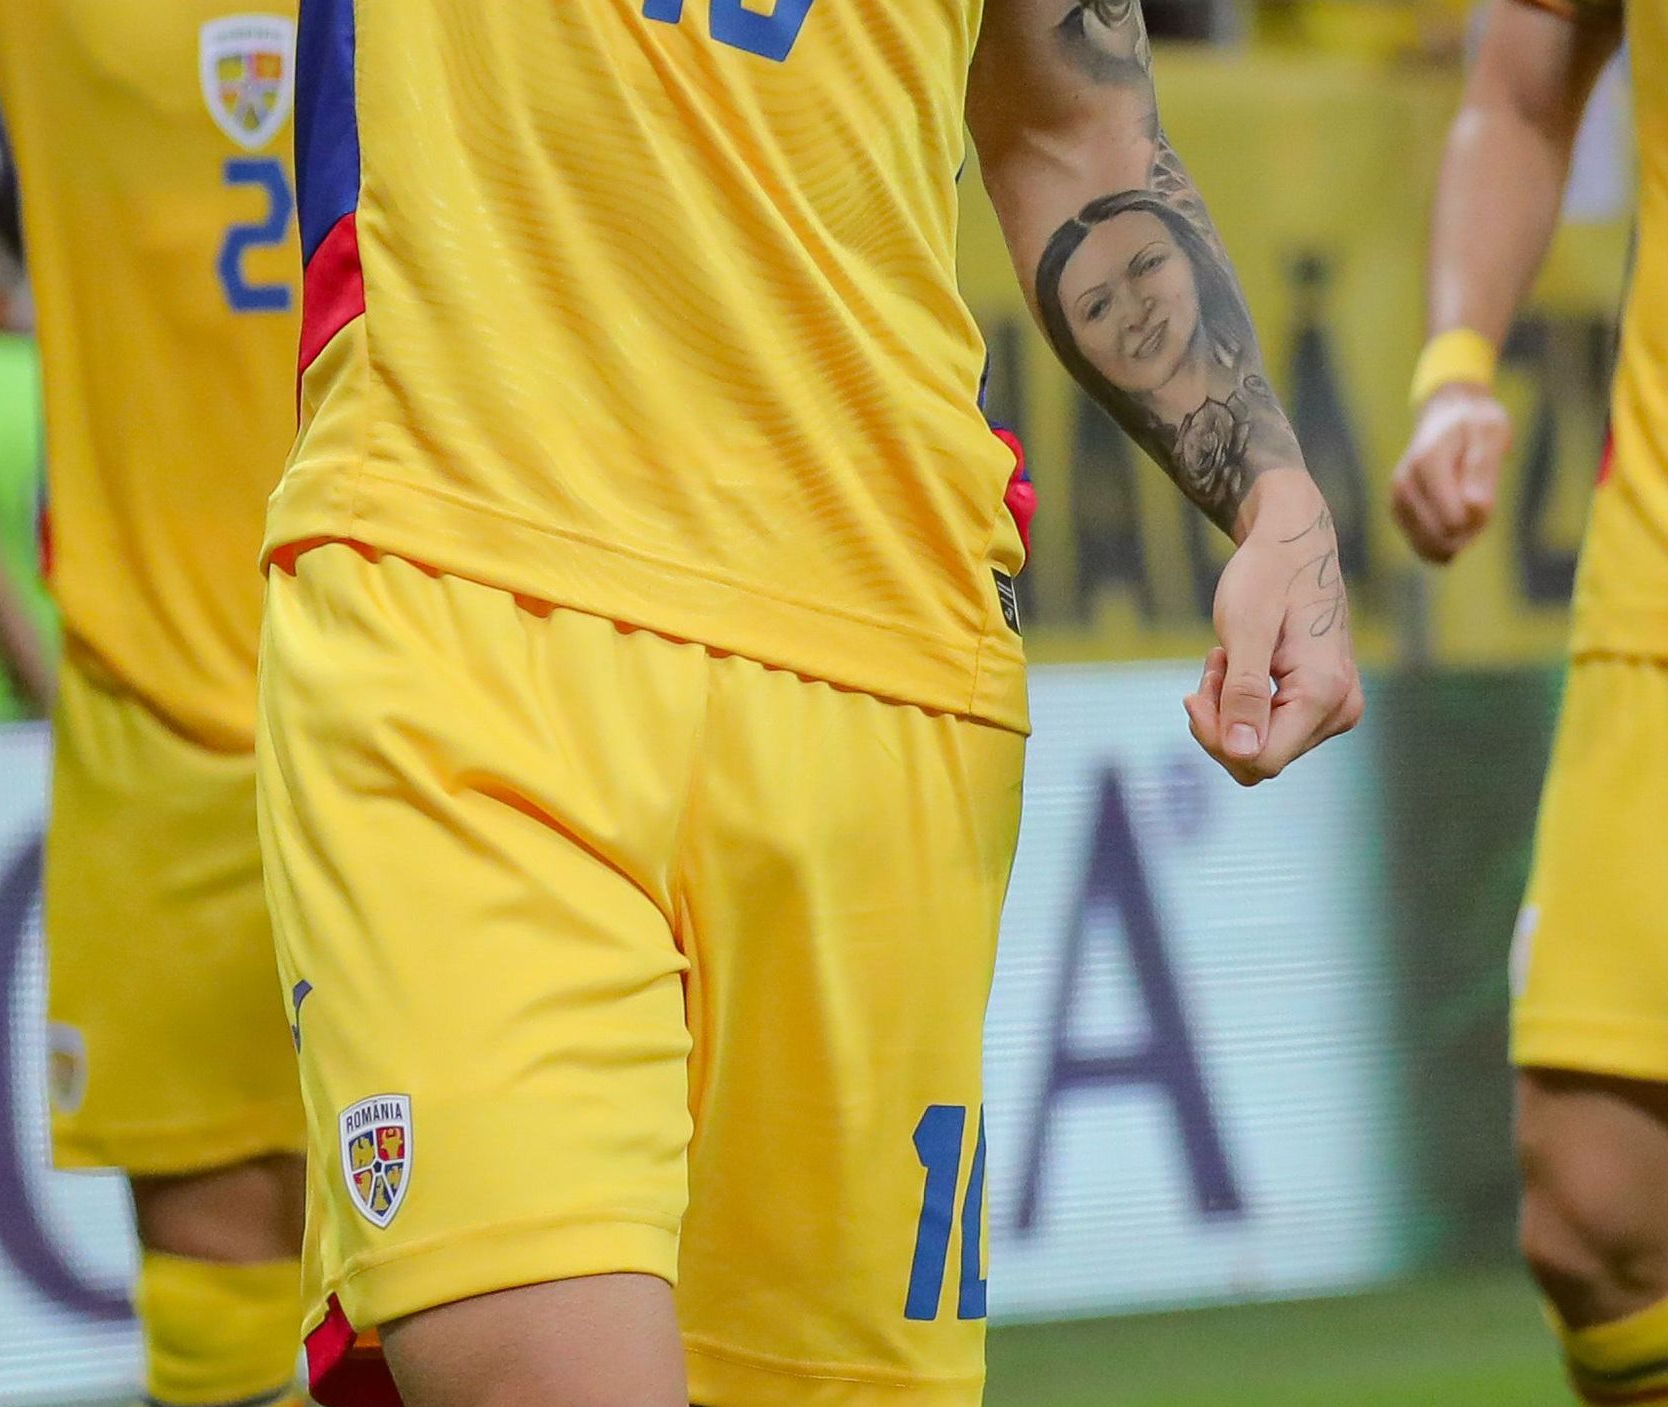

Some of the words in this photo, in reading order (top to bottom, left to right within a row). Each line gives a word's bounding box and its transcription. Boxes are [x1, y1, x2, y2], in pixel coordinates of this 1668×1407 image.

[217, 156, 293, 312] 2
[346, 1100, 403, 1133] ROMÂNIA
[903, 1103, 988, 1321] 1
